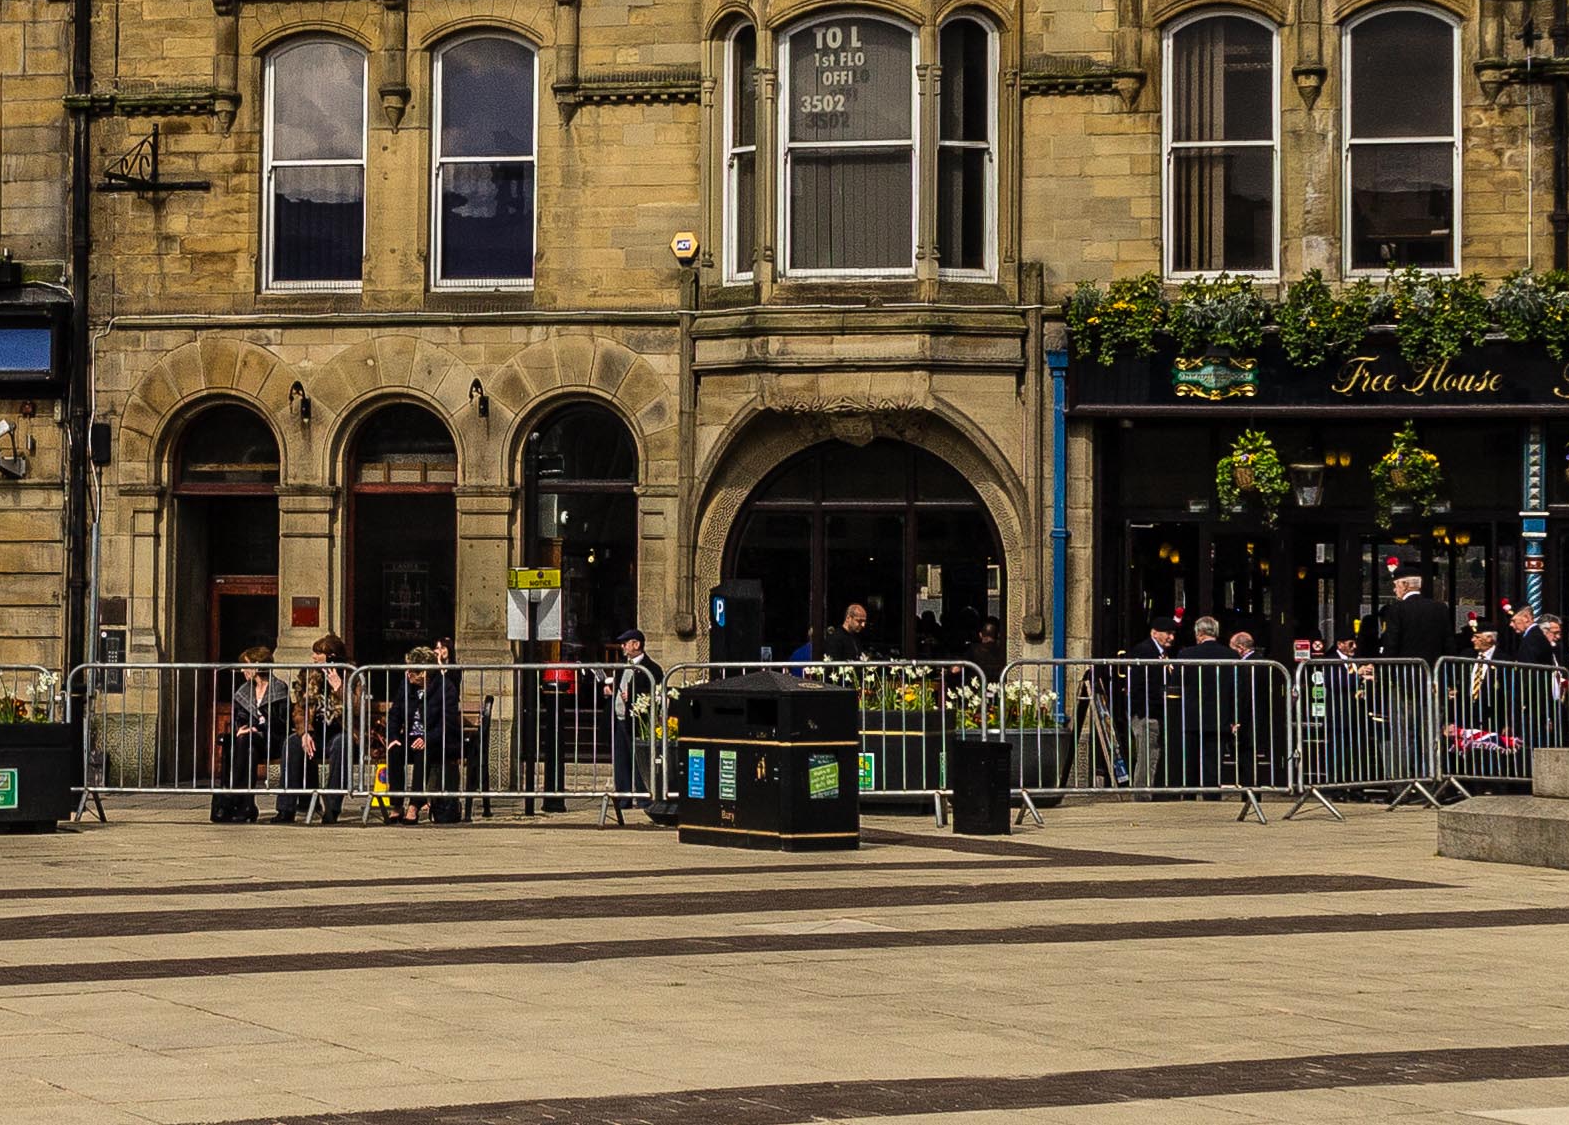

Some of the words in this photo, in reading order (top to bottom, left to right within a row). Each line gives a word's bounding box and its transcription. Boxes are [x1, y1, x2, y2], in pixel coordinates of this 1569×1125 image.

[812, 26, 843, 50] TO
[814, 52, 835, 67] 1st
[839, 51, 866, 67] FLO
[822, 70, 853, 86] OFFI
[800, 94, 845, 113] 3502
[1331, 355, 1398, 397] Free
[1401, 357, 1503, 397] House
[528, 579, 552, 587] NOTICE
[715, 599, 725, 623] P
